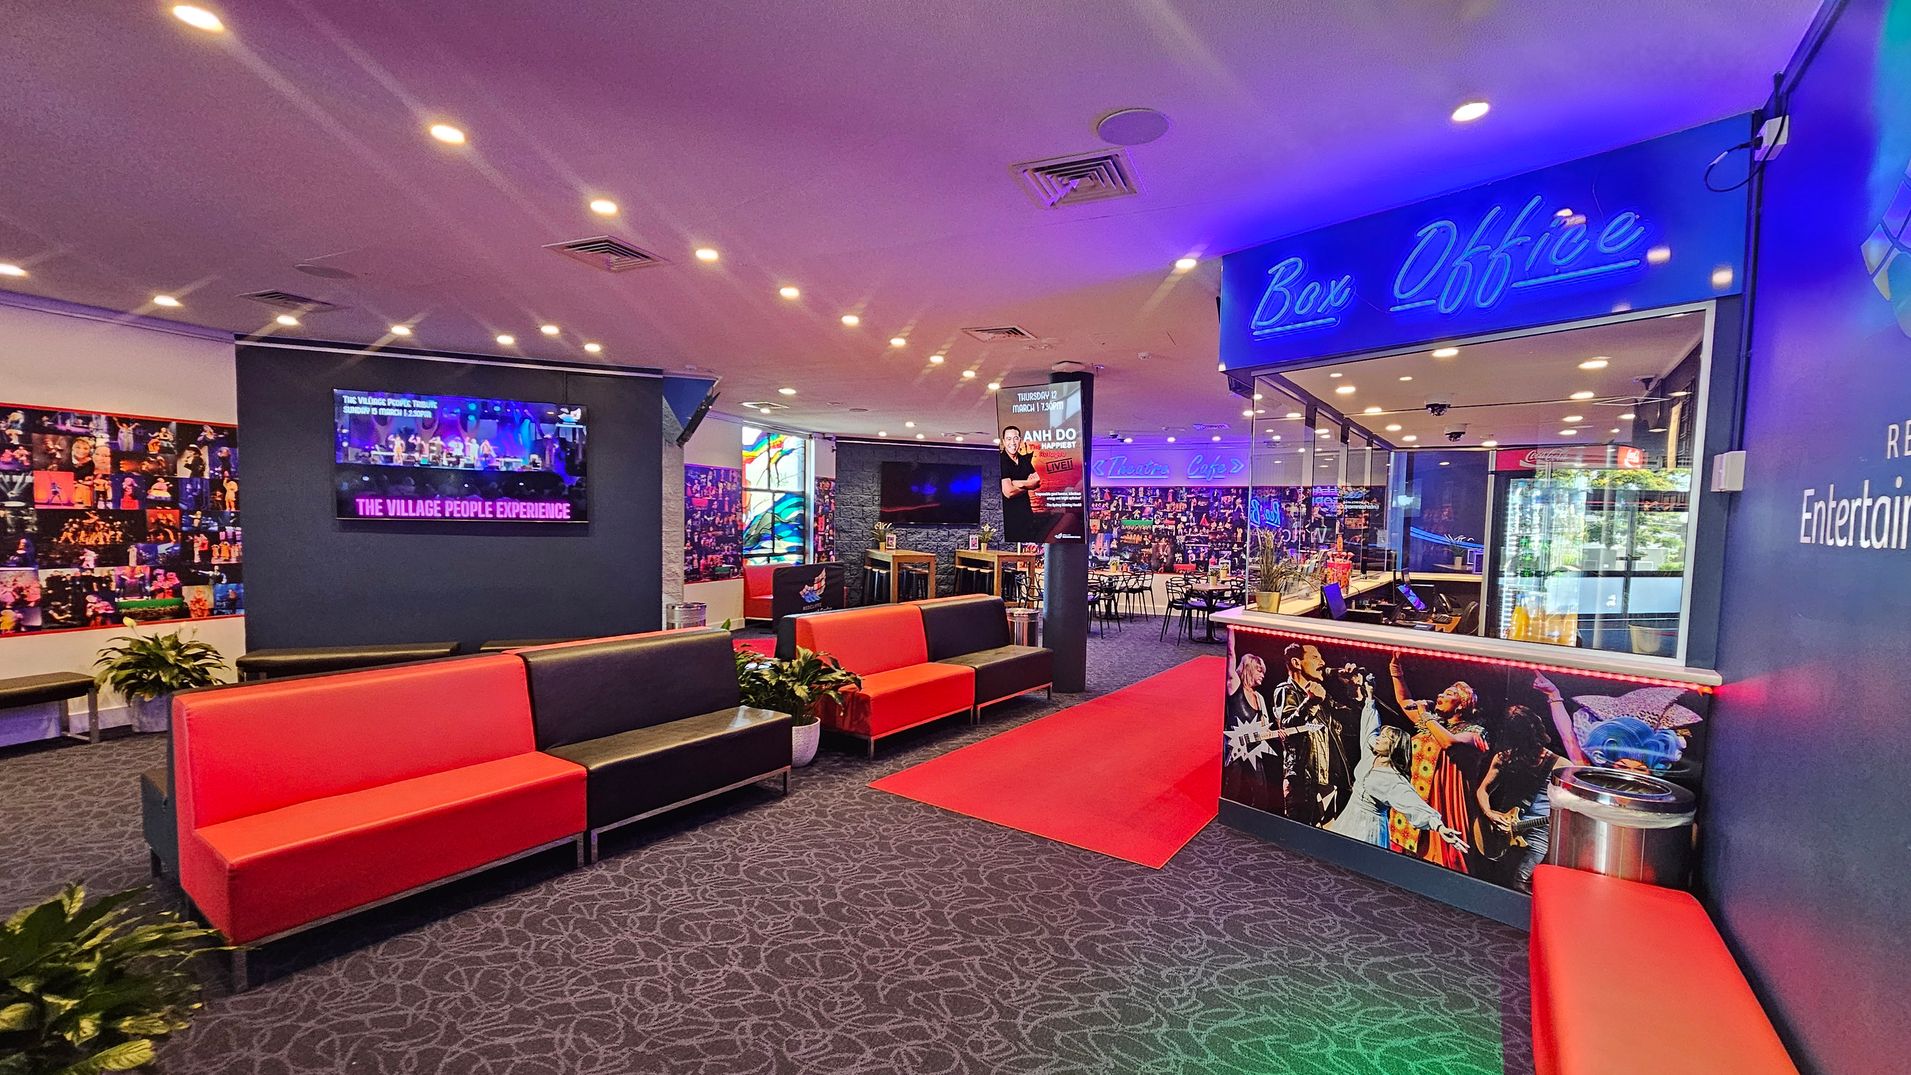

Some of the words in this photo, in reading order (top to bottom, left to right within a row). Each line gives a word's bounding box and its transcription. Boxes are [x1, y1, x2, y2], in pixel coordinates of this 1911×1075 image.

[1251, 257, 1351, 329] Box
[1392, 195, 1646, 314] Office
[342, 395, 357, 404] THE
[357, 396, 387, 406] VILLAGE
[387, 398, 412, 408] PEOPLE
[412, 399, 438, 409] TRIBUTE
[1017, 391, 1050, 402] THURSDAY
[1051, 390, 1058, 399] 12
[342, 406, 371, 415] SUNDAY
[378, 408, 403, 417] MARCH
[1012, 403, 1035, 413] MARCH
[1023, 429, 1052, 442] ANH
[1055, 428, 1077, 441] DO
[1041, 441, 1077, 450] HAPPIEST
[1107, 455, 1169, 476] Theatre
[1187, 455, 1227, 481] Cafe
[355, 498, 384, 517] THE
[386, 499, 442, 518] VILLAGE
[444, 500, 493, 519] PEOPLE
[495, 502, 571, 520] EXPERIENCE
